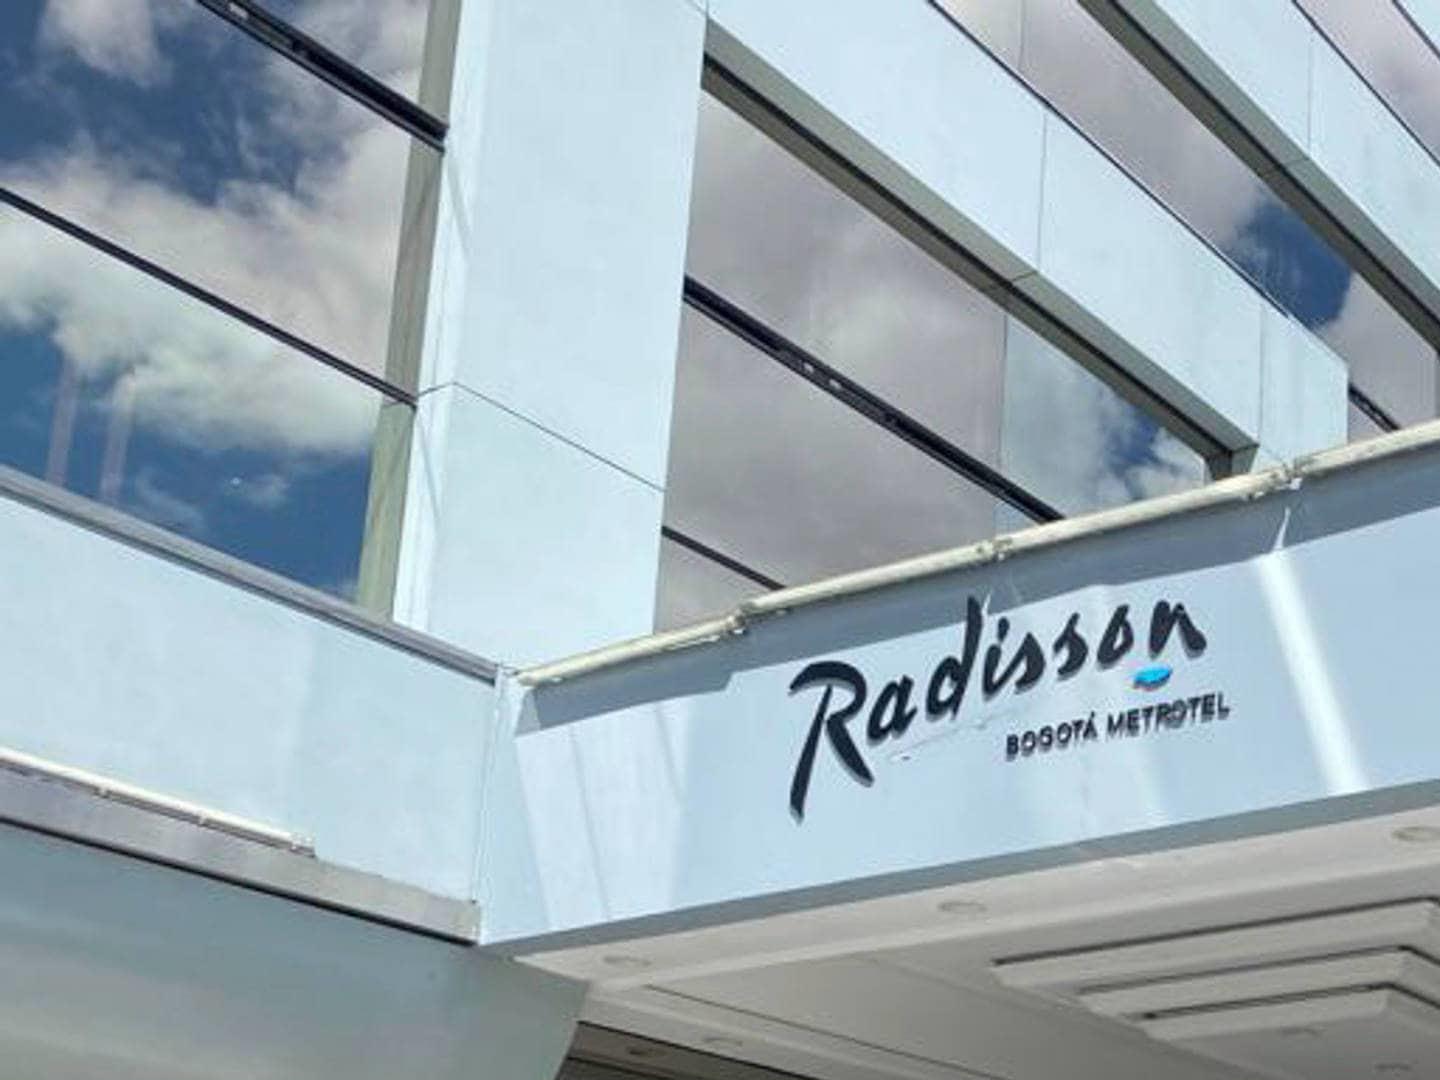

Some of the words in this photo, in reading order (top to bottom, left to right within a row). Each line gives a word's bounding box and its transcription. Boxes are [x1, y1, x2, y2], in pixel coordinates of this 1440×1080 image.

[789, 595, 1207, 824] Radisson
[1006, 712, 1098, 761] BOGOTÁ
[1107, 691, 1231, 738] METROTEL
